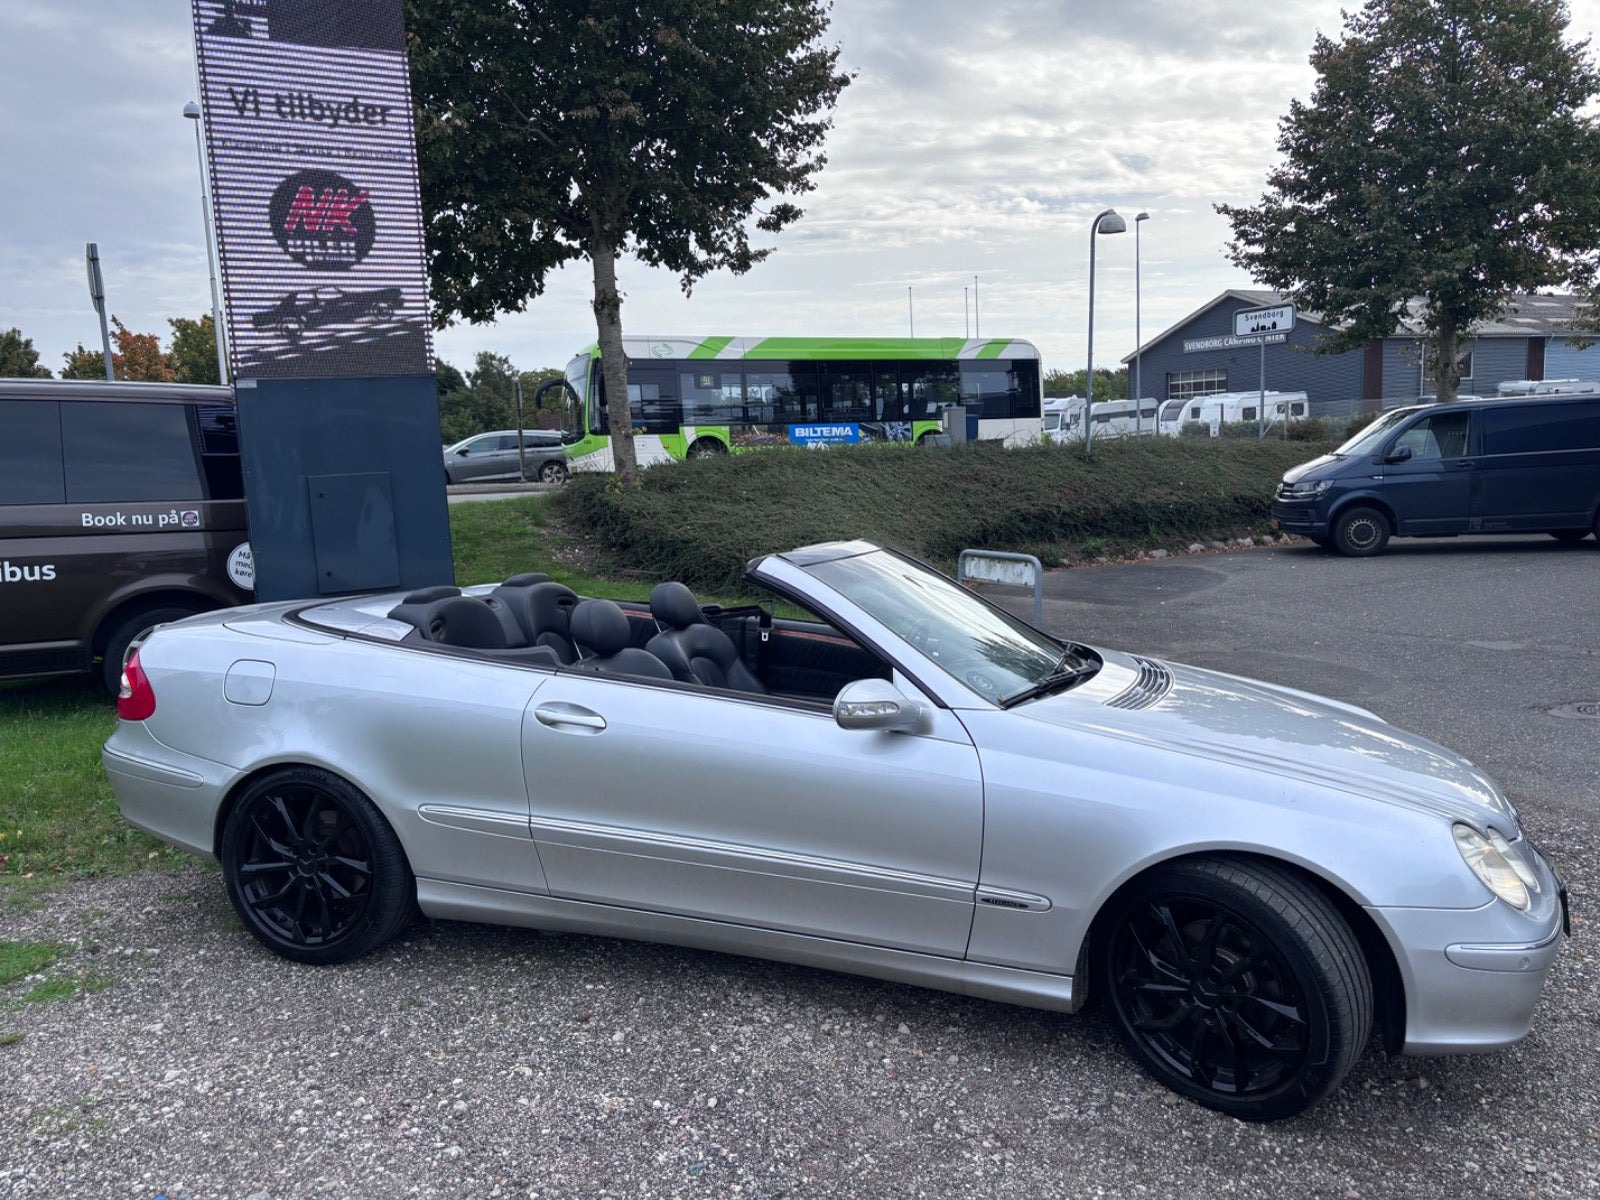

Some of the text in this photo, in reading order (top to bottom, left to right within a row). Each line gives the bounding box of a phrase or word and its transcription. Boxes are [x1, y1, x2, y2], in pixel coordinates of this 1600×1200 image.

[275, 92, 391, 128] tilbyder
[284, 186, 368, 232] NK
[1244, 311, 1284, 321] Svendborg
[1184, 338, 1222, 351] SVENDBORG
[795, 427, 853, 437] BILTEMA
[81, 512, 127, 527] Book
[131, 514, 153, 525] nu
[158, 509, 179, 528] på
